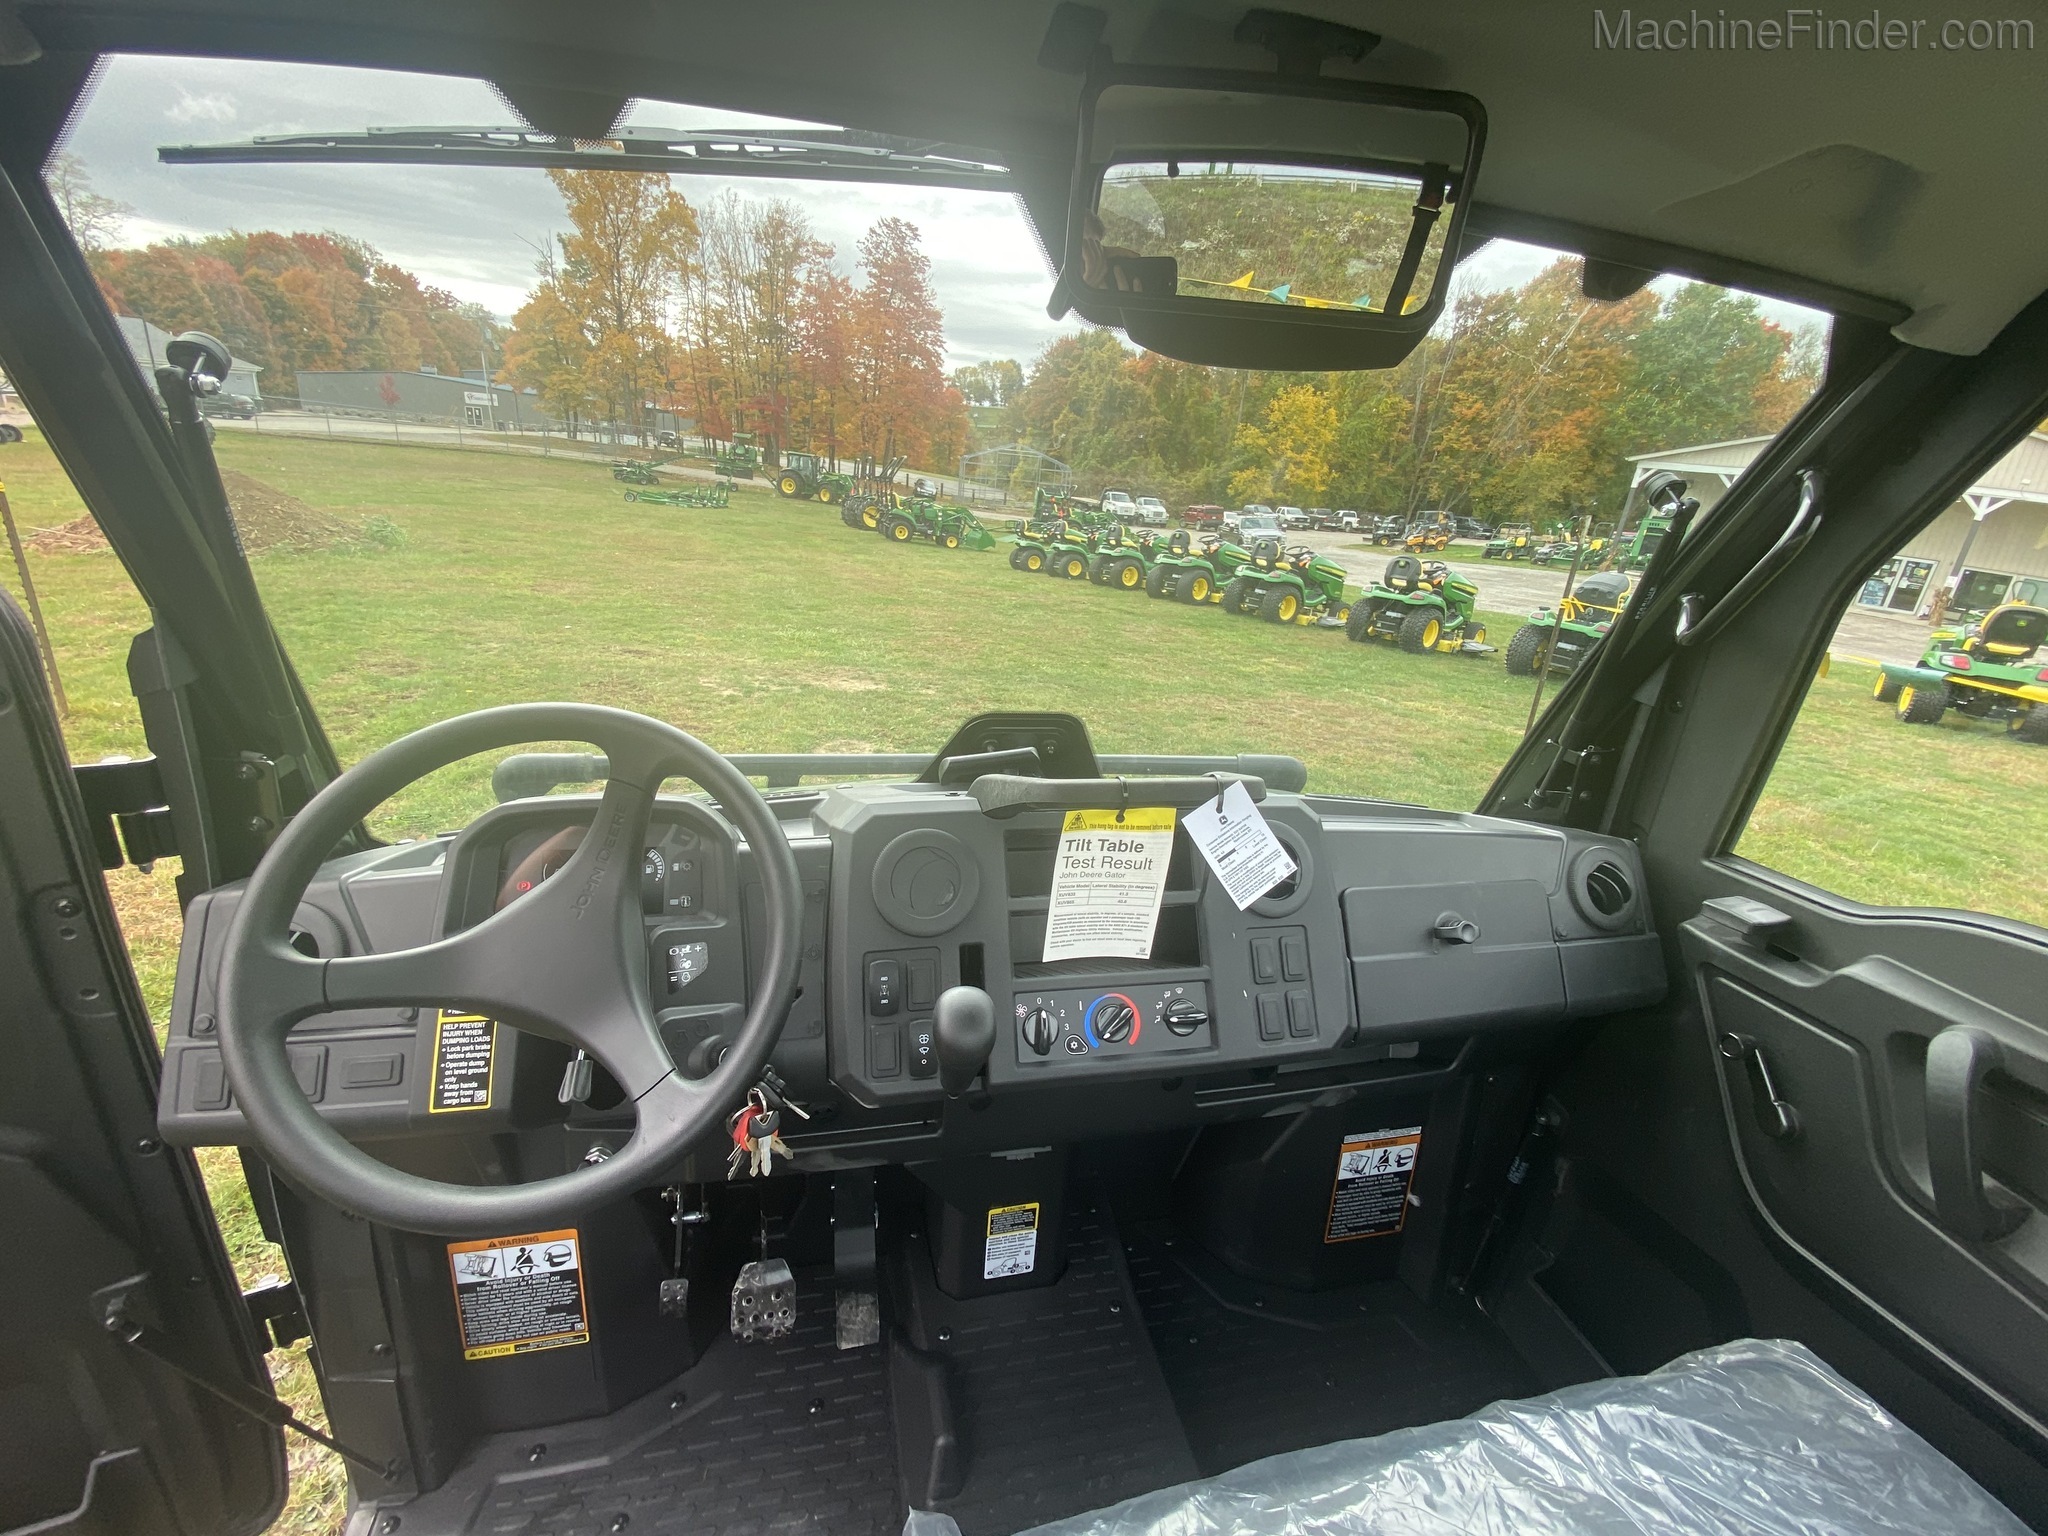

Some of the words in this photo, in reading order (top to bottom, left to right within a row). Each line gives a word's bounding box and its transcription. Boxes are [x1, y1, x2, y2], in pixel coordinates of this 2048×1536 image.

[1064, 839, 1092, 852] Tilt
[1096, 838, 1145, 854] Table
[570, 868, 606, 919] JOHN
[596, 802, 628, 863] DEERE
[1061, 856, 1096, 869] Test
[1101, 855, 1154, 871] Result
[1104, 871, 1126, 879] Gator
[1037, 997, 1042, 1005] 0
[1064, 1023, 1070, 1031] 3
[445, 1061, 468, 1069] Operate
[468, 1067, 488, 1075] ground
[444, 1076, 457, 1084] only
[498, 1236, 539, 1246] WARNING
[478, 1347, 511, 1356] CAUTION
